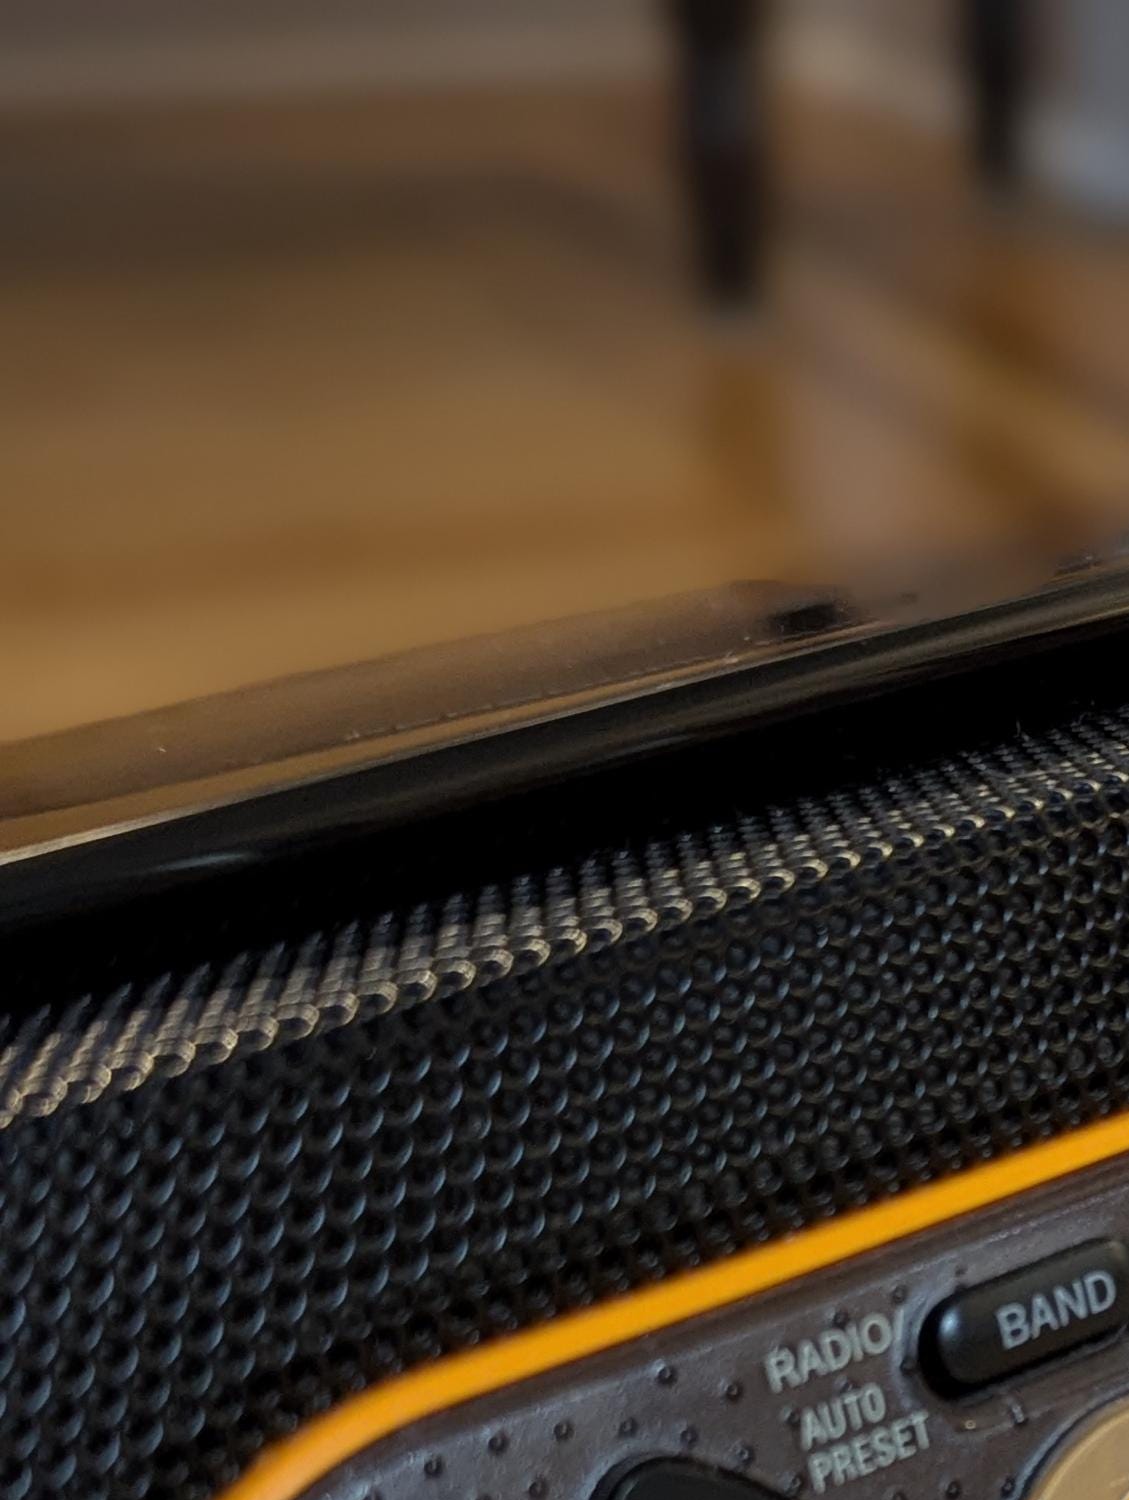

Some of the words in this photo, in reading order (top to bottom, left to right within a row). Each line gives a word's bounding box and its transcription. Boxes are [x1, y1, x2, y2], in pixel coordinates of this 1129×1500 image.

[995, 1271, 1116, 1350] BAND
[800, 1382, 885, 1450] AUTO
[807, 1410, 930, 1493] PRESET
